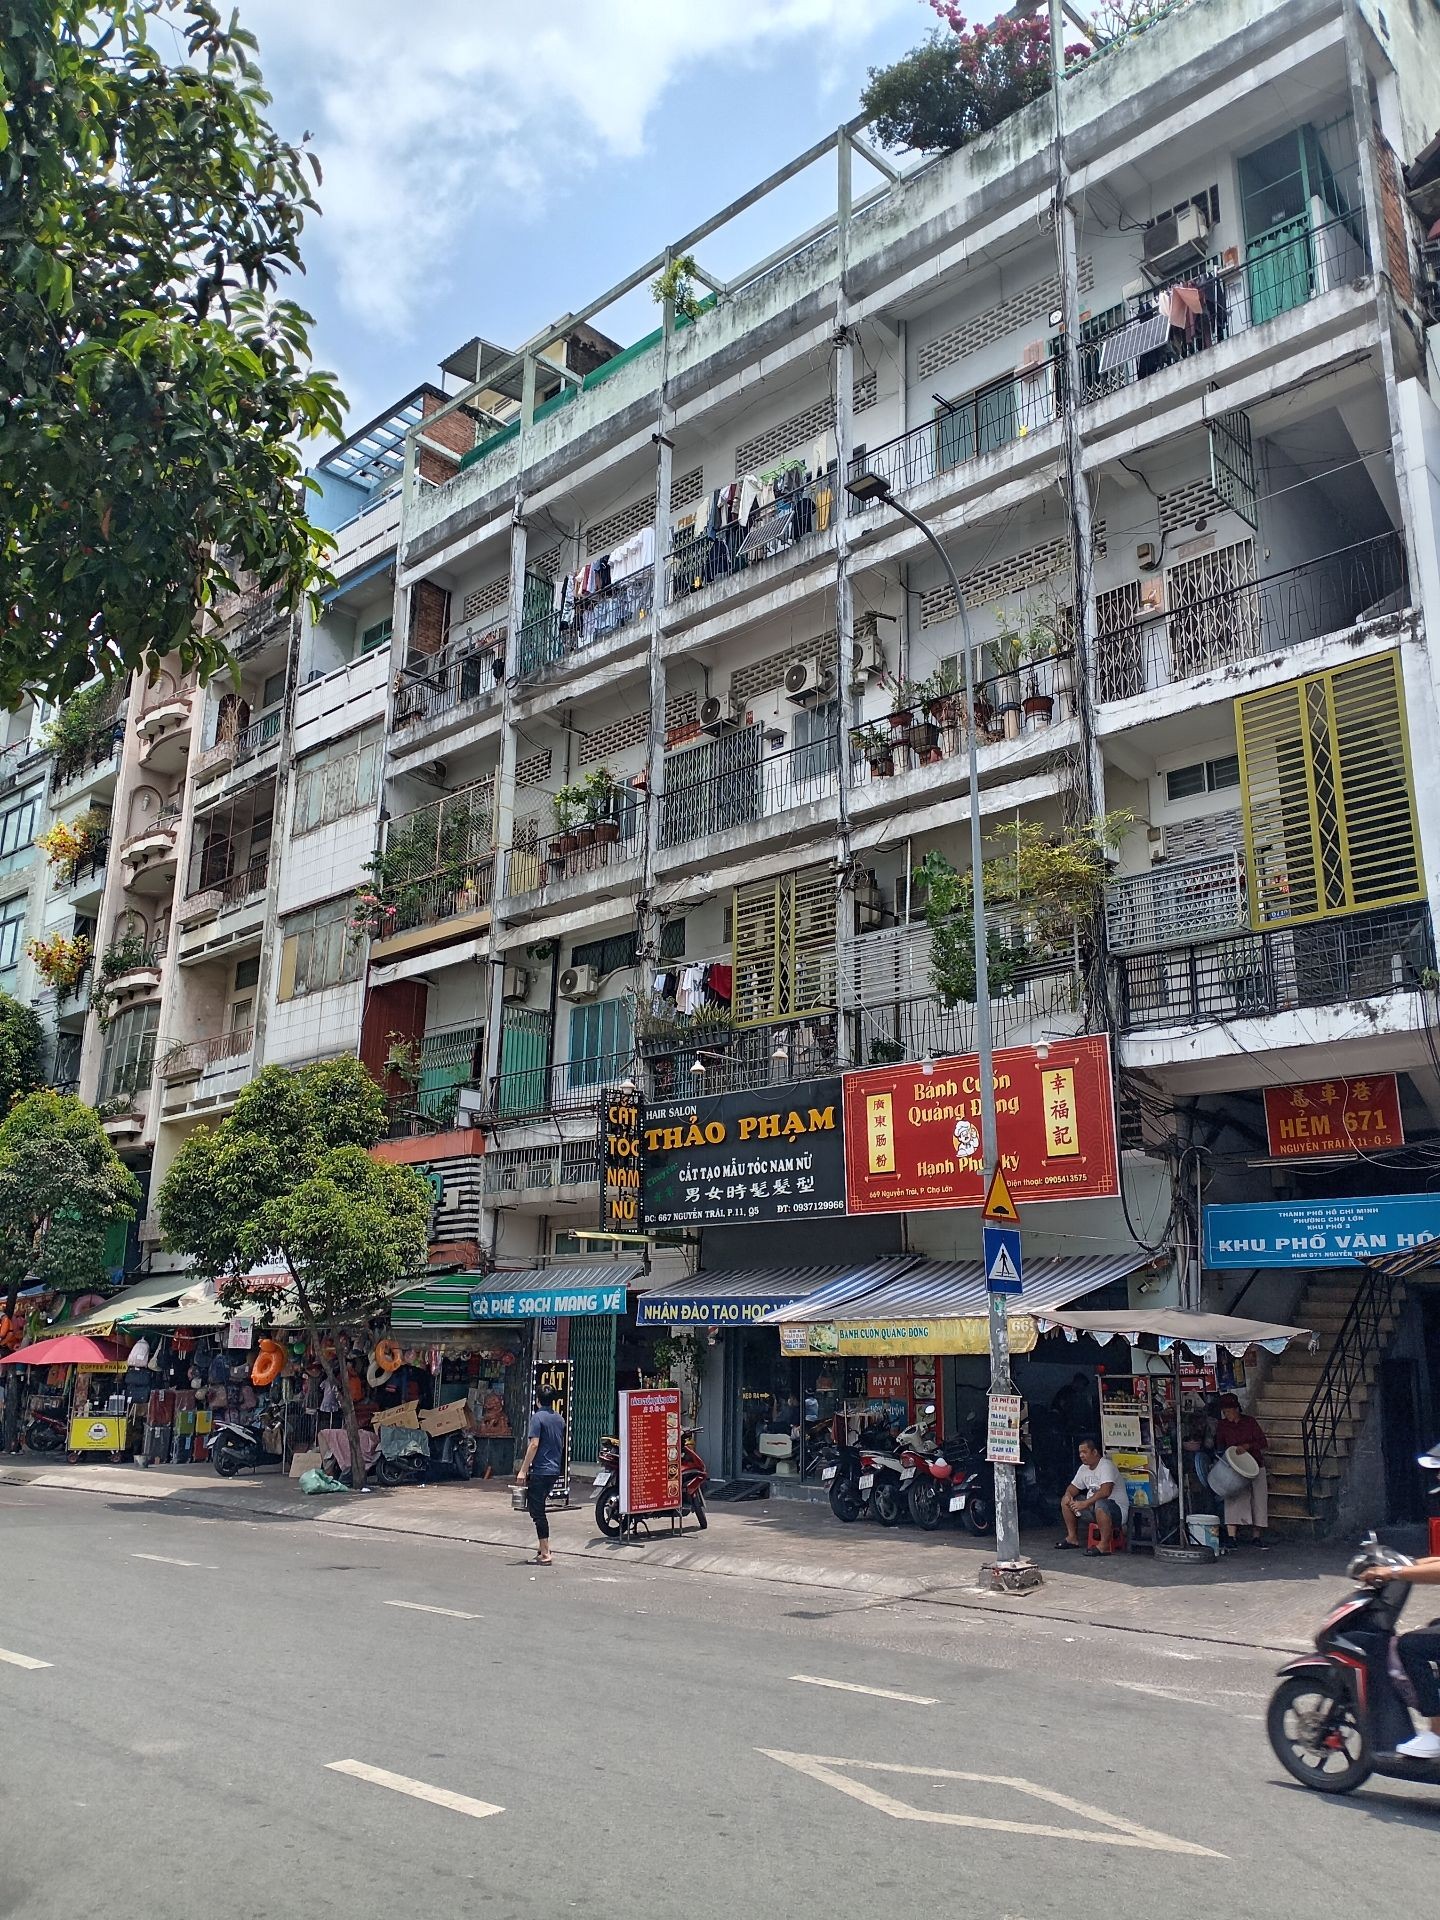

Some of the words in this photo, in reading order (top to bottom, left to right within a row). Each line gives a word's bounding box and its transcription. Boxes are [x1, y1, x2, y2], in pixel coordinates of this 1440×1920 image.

[913, 1078, 958, 1101] Bánh
[609, 1096, 638, 1126] CẮT
[646, 1108, 666, 1120] HAIR
[668, 1105, 697, 1118] SALON
[908, 1101, 965, 1127] Quảng
[970, 1096, 1020, 1117] Đng
[1050, 1073, 1072, 1146] 幸福記
[644, 1115, 726, 1151] THẢO
[738, 1106, 835, 1143] PHẠM
[1280, 1110, 1331, 1139] HẺM
[1344, 1109, 1387, 1132] 671
[608, 1131, 640, 1157] TÓC
[1280, 1138, 1319, 1154] NGUYỄN
[1322, 1137, 1345, 1151] TRÃI
[607, 1166, 640, 1188] NAM
[679, 1162, 698, 1182] CẮT
[700, 1166, 721, 1182] TẠO
[722, 1157, 745, 1178] MẪU
[747, 1157, 768, 1175] TÓC
[770, 1158, 794, 1173] NAM
[795, 1151, 813, 1170] NỮ
[917, 1158, 955, 1178] Hạnh
[959, 1154, 985, 1173] Phú
[1001, 1151, 1020, 1171] ký
[869, 1190, 880, 1199] 669
[926, 1186, 941, 1194] Chợ
[1007, 1179, 1022, 1188] Điện
[1023, 1178, 1043, 1186] thoại:
[1044, 1174, 1088, 1185] 0905413575
[612, 1194, 635, 1220] NỮ
[644, 1215, 657, 1223] ĐC:
[658, 1213, 672, 1222] 667
[748, 1206, 760, 1217] Q5
[777, 1204, 791, 1213] ĐT:
[793, 1200, 844, 1213] 0937129966
[1219, 1238, 1266, 1252] KHU
[1275, 1232, 1327, 1250] PHỐ
[1334, 1233, 1387, 1248] VĂN
[1397, 1229, 1434, 1247] HÓ
[472, 1295, 489, 1315] CÀ
[491, 1295, 515, 1314] PHÊ
[518, 1297, 550, 1317] SẠCH
[554, 1294, 597, 1312] MANG
[602, 1288, 621, 1310] VỀ
[681, 1300, 709, 1320] ĐÀO
[712, 1304, 739, 1323] TẠO
